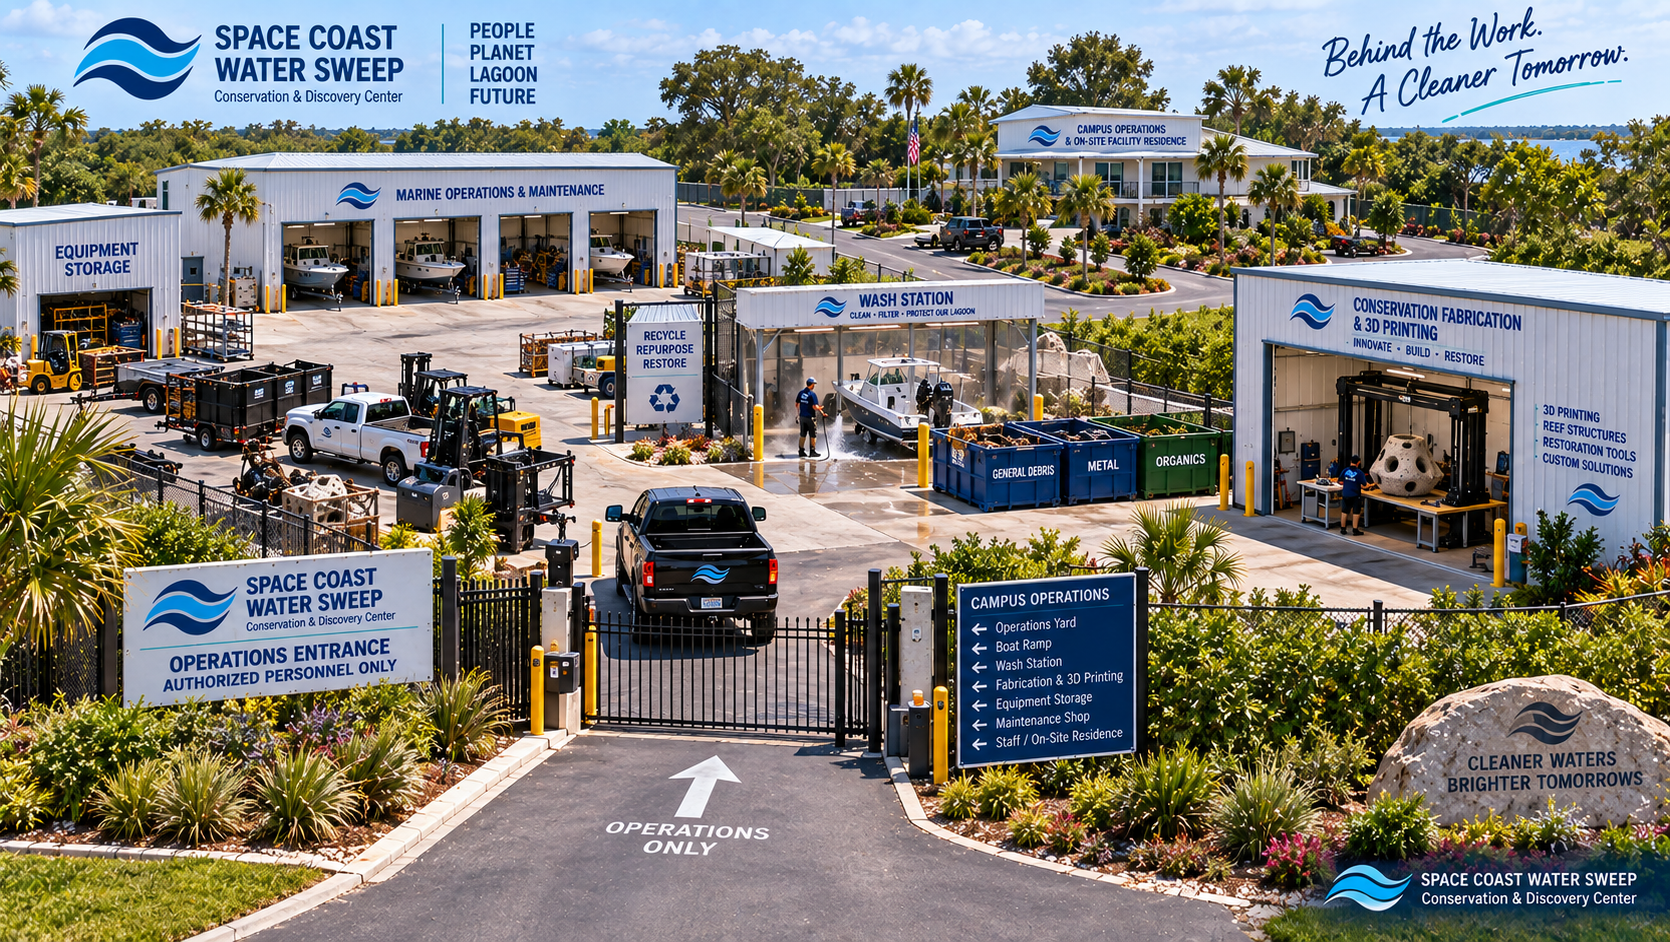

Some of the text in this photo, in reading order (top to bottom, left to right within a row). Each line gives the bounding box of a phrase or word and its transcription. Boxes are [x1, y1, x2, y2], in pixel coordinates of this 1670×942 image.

[1077, 125, 1166, 134] CAMPUS OPERATIONS
[1065, 137, 1186, 146] & ON-SITE FACILITY RESIDENCE
[396, 184, 604, 201] MARINE OPERATIONS & MAINTENANCE
[56, 242, 139, 260] EQUIPMENT
[65, 260, 130, 276] STORAGE
[859, 291, 953, 307] WASH STATION
[906, 309, 934, 317] PROTECT
[950, 308, 975, 316] LAGOON
[1354, 297, 1521, 331] CONSERVATION FABRICATION
[644, 330, 686, 341] RECYCLE
[1354, 316, 1437, 341] & 3D PRINTING
[636, 344, 694, 355] REPURPOSE
[1354, 338, 1484, 366] INNOVATE BUILD RESTORE
[643, 358, 687, 369] RESTORE
[1543, 404, 1600, 423] 3D PRINTING
[1543, 420, 1626, 444] REEF STRUCTURES
[1543, 436, 1636, 462] RESTORATION TOOLS
[1088, 459, 1119, 471] METAL
[1156, 454, 1205, 467] ORGANICS
[1543, 453, 1634, 478] CUSTOM SOLUTIONS
[993, 465, 1054, 479] GENERAL DEBRIS
[246, 568, 377, 595] SPACE COAST
[246, 589, 383, 617] WATER SWEEP
[971, 588, 1109, 609] CAMPUS OPERATIONS
[246, 611, 396, 631] Conservation & Discovery Center
[996, 616, 1076, 635] Operations Yard
[996, 639, 1052, 652] Boat Ramp
[170, 638, 390, 673] OPERATIONS ENTRANCE
[996, 656, 1062, 671] Wash Station
[163, 659, 397, 692] AUTHORIZED PERSONNEL ONLY
[996, 670, 1123, 690] Fabrication & 3D Printing
[996, 693, 1092, 711] Equipment Storage
[996, 711, 1090, 728] Maintenance Shop
[996, 728, 1123, 748] Staff / On-Site Residence
[1468, 751, 1616, 771] CLEANER WATERS
[1448, 771, 1643, 793] BRIGHTER TOMORROWS
[606, 822, 769, 840] OPERATIONS
[643, 840, 717, 856] ONLY
